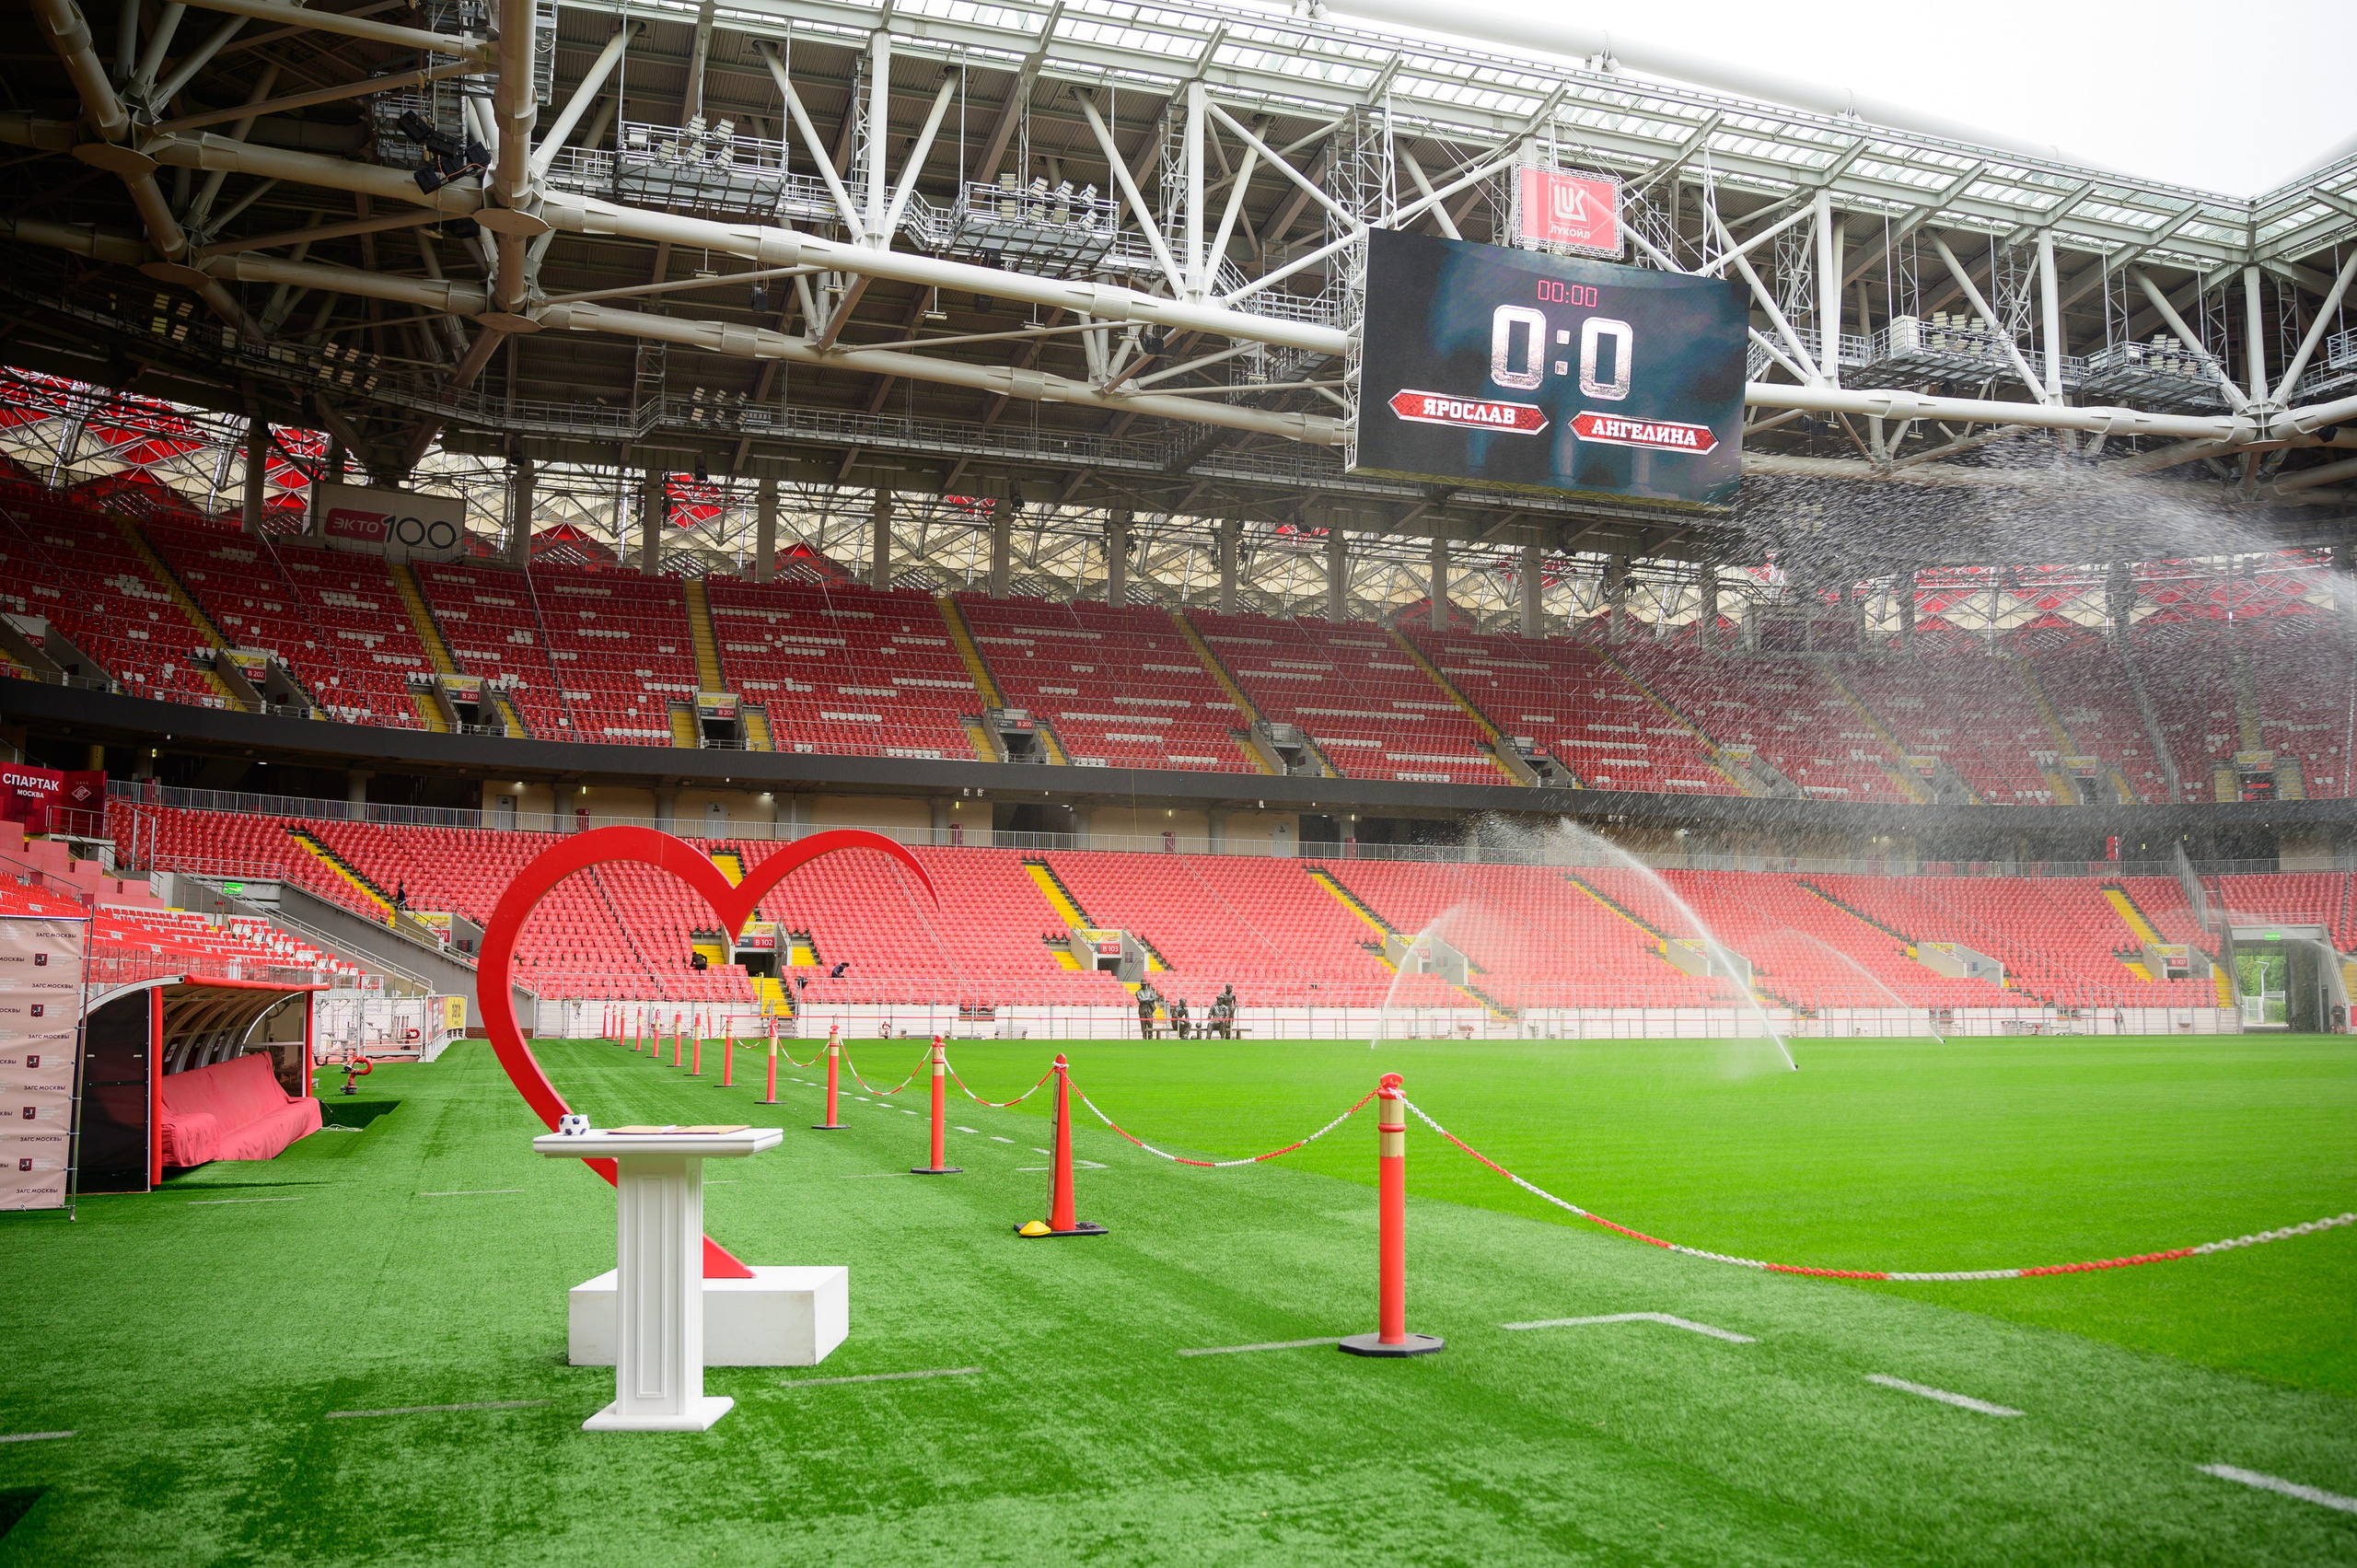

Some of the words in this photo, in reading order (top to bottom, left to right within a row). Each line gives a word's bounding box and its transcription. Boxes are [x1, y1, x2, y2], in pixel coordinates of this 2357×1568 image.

[1550, 226, 1590, 238] ЛУКОЙЛ
[1537, 280, 1597, 308] 00:00
[1490, 304, 1633, 401] 0:0
[1422, 398, 1515, 426] ЯРОСЛАВ
[1591, 418, 1697, 447] АНГЕЛИНА
[332, 517, 379, 533] ЭКТО
[382, 515, 457, 550] 100
[3, 773, 60, 792] СПАРТАК
[17, 789, 44, 798] МОСКВА
